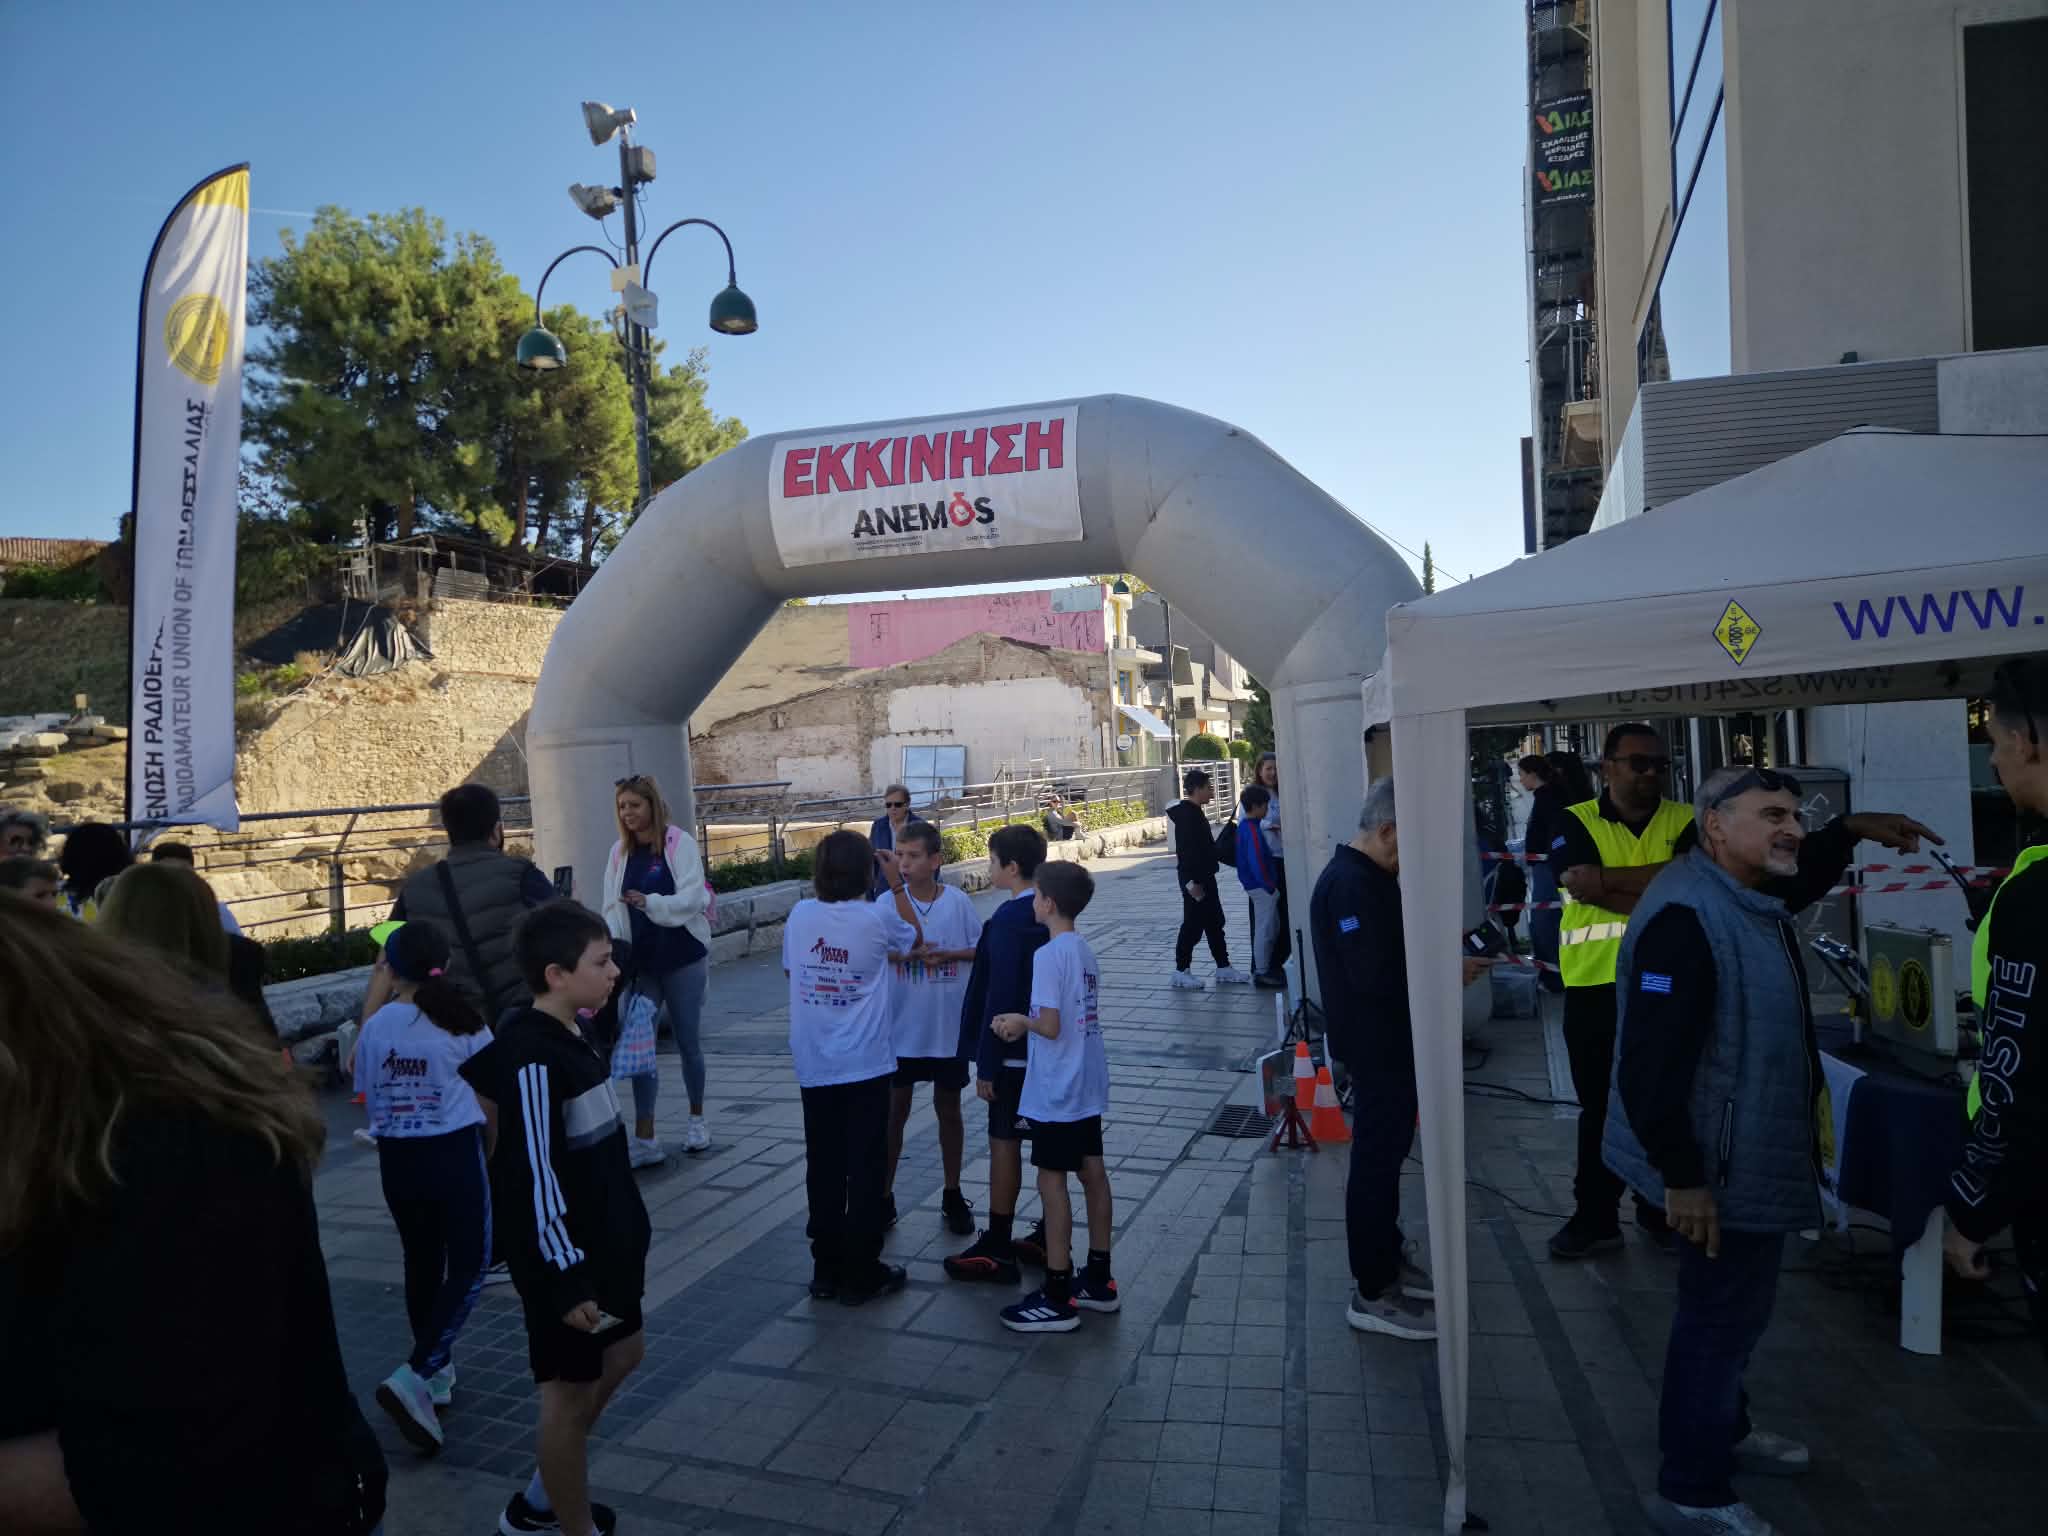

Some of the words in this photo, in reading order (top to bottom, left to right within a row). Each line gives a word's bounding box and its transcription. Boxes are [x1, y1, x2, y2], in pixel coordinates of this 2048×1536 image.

[783, 418, 1065, 498] ΕΚΚΙΝΗΣΗ
[852, 491, 995, 539] ANEMOS
[174, 577, 193, 601] OF
[172, 606, 193, 671] UNION
[145, 751, 169, 821] ΕΝΩΣΗ
